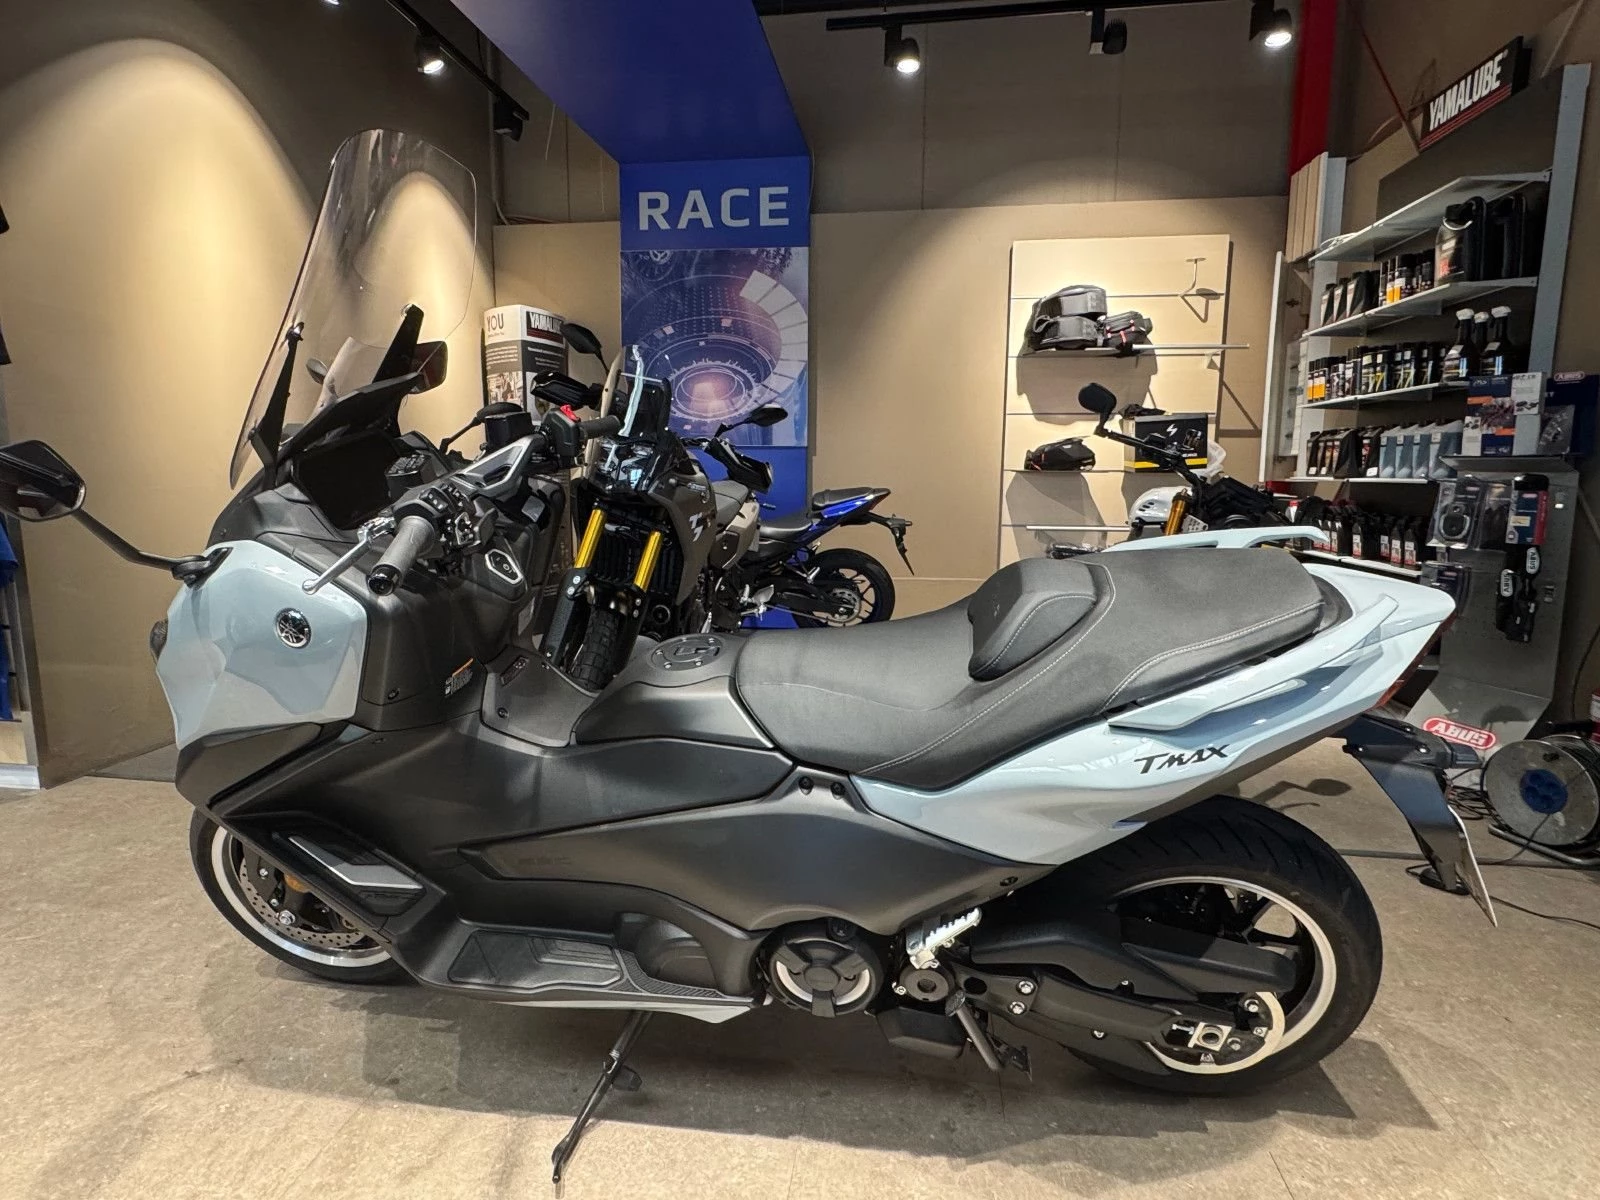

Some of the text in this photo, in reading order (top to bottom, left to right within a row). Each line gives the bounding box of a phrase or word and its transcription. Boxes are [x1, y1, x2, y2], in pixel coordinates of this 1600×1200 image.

[1429, 51, 1504, 132] YAMALUBE
[638, 186, 790, 231] RACE
[486, 312, 504, 332] YOU
[1430, 722, 1488, 746] ABUS
